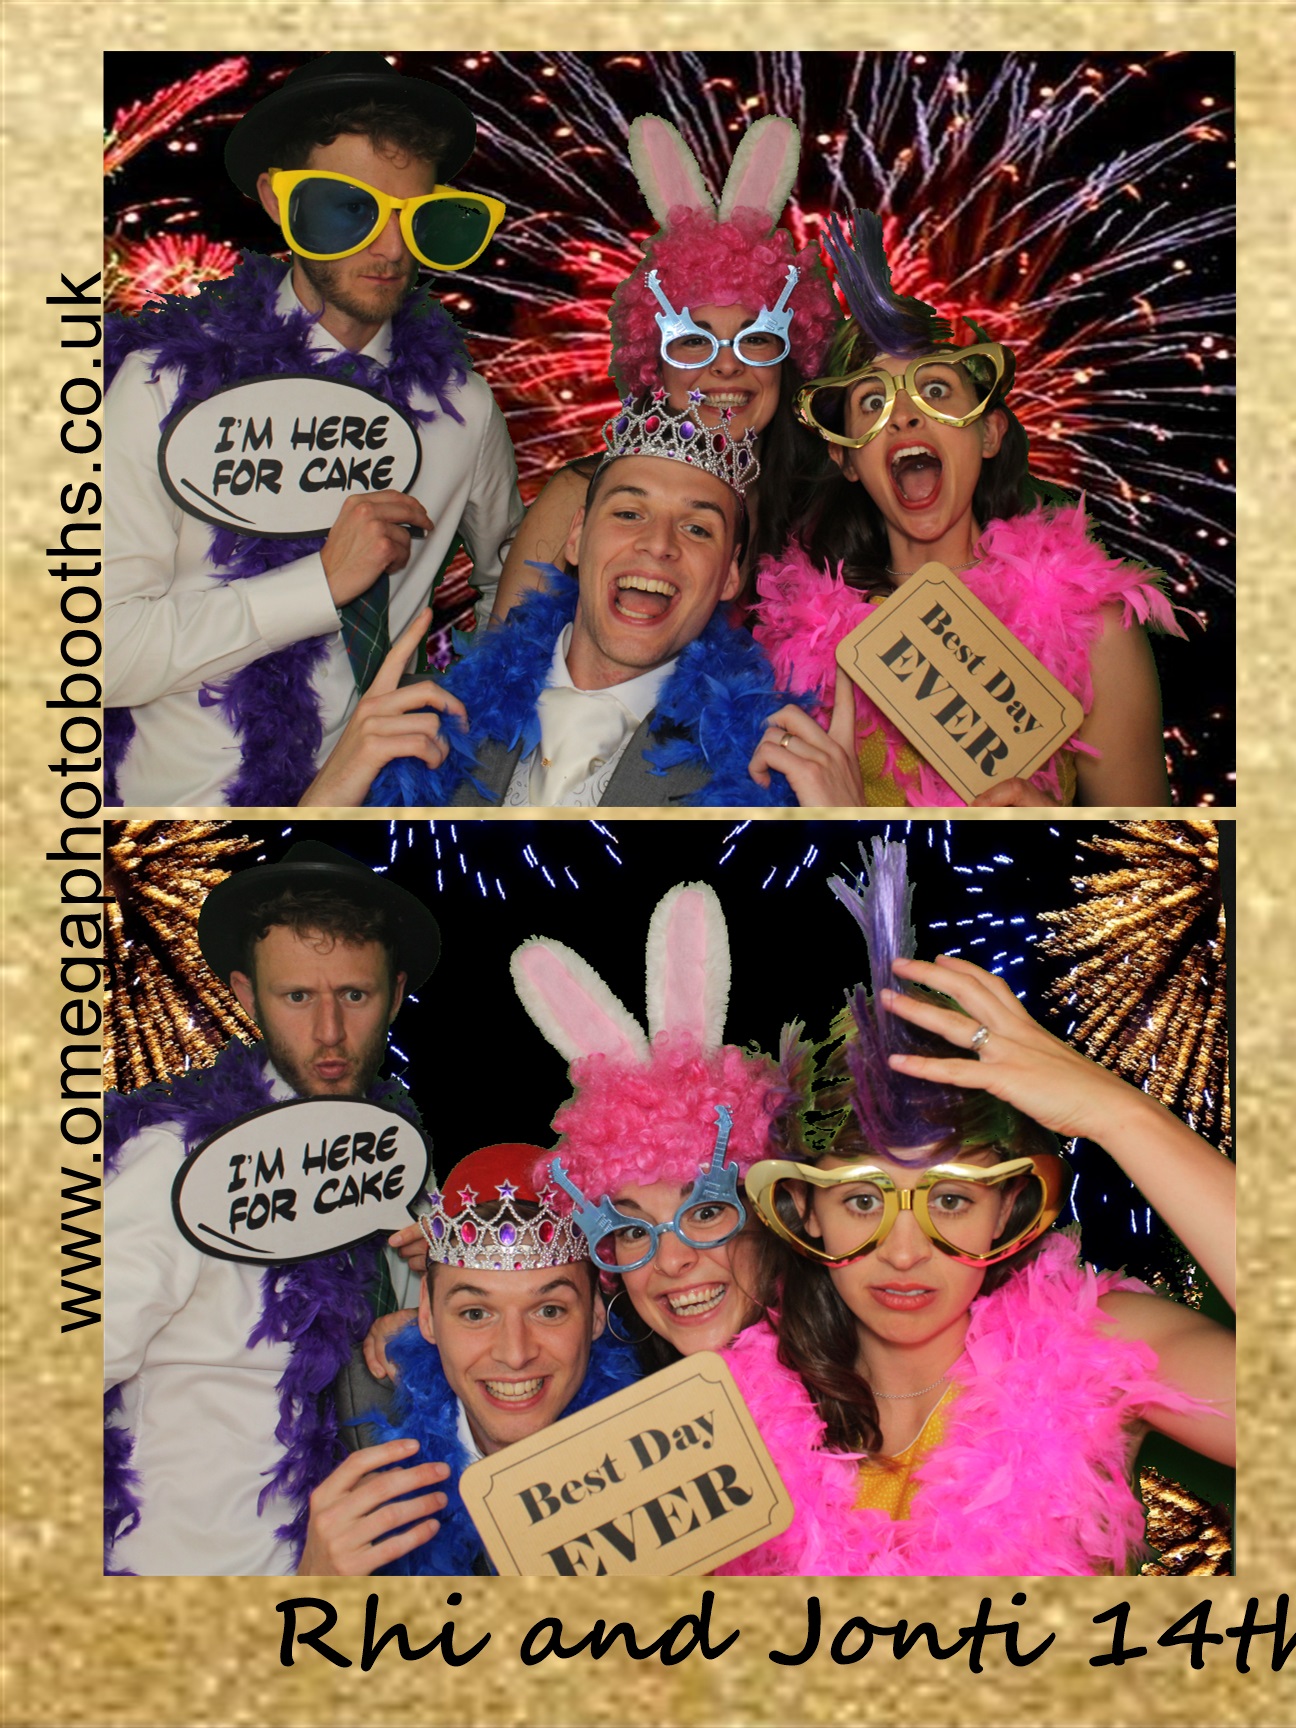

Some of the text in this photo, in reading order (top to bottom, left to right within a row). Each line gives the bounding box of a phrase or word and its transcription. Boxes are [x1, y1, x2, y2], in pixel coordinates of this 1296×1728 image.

[214, 415, 389, 453] I'M HERE
[212, 455, 395, 496] FOR CAKE
[917, 600, 1044, 735] Best Day
[876, 630, 1009, 777] EVER
[227, 1125, 399, 1193] I'M HERE
[229, 1164, 406, 1234] FOR CAKE
[513, 1409, 716, 1527] Best Day
